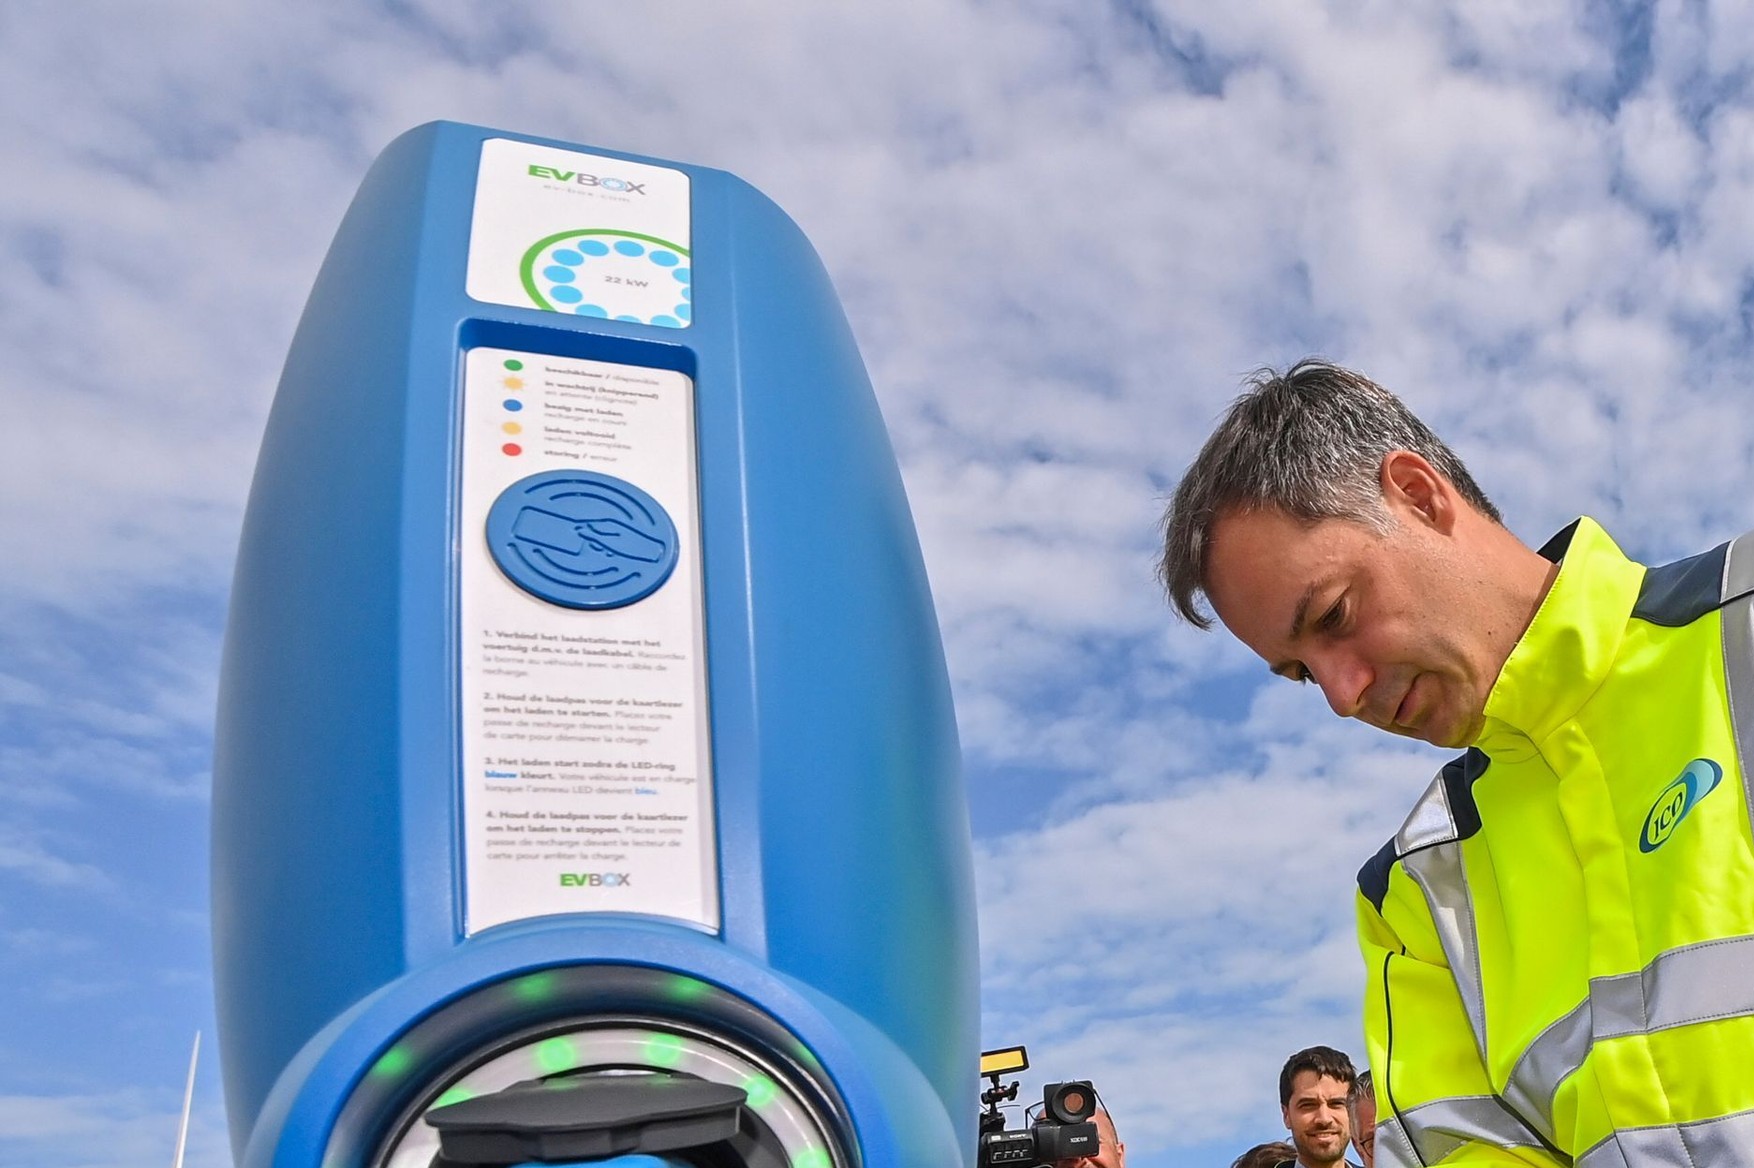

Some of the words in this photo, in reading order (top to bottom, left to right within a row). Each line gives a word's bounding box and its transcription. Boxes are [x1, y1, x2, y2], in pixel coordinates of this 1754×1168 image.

[527, 164, 646, 196] EVBOX
[604, 275, 622, 285] 22
[626, 278, 649, 288] kW
[541, 633, 558, 642] het
[644, 639, 661, 647] het
[566, 647, 579, 655] de
[497, 693, 526, 701] Houd
[616, 698, 629, 706] de
[503, 706, 521, 714] het
[615, 761, 628, 769] de
[484, 771, 518, 779] blauw
[499, 811, 529, 819] Houd
[532, 811, 546, 819] de
[620, 813, 634, 821] de
[1653, 791, 1683, 841] ICO
[560, 873, 630, 887] EVBOX
